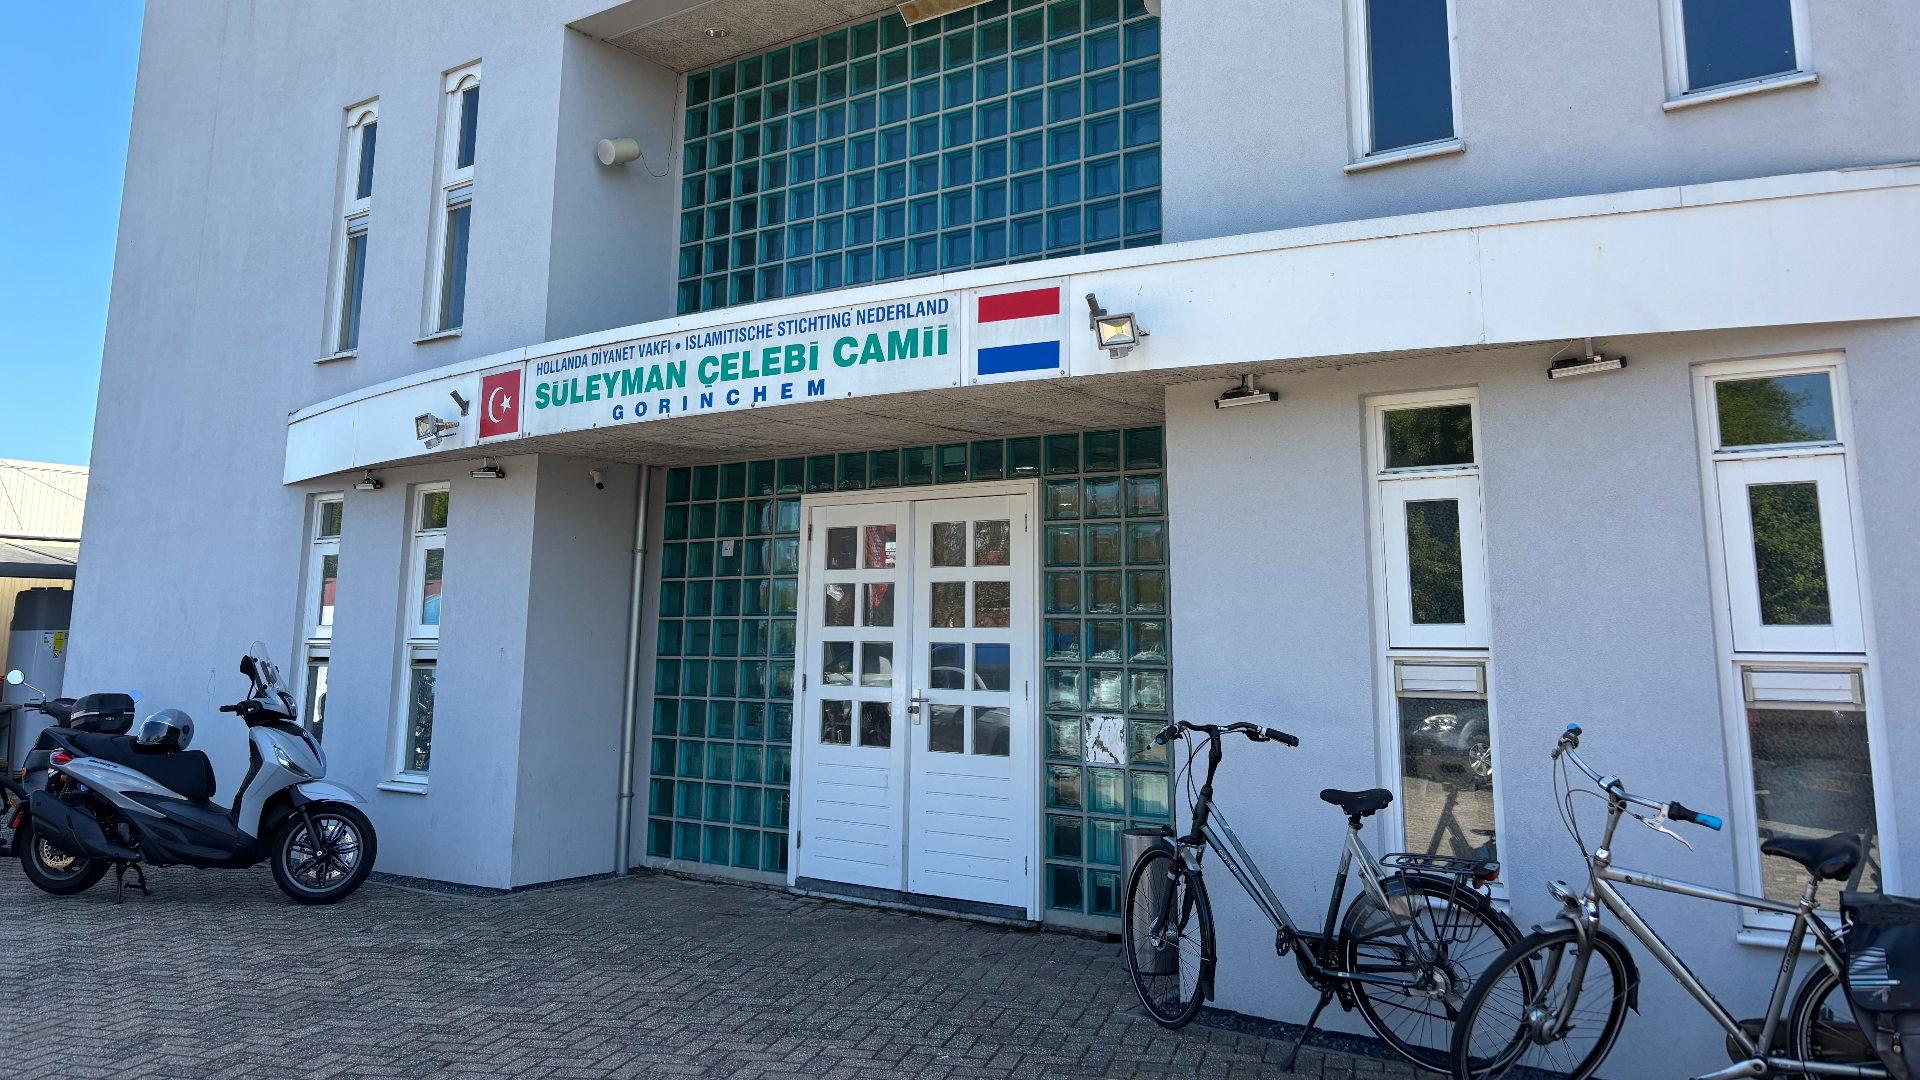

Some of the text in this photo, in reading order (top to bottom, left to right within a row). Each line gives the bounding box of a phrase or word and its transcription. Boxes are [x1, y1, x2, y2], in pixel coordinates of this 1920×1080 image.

[536, 354, 588, 376] HOLLANDA
[638, 340, 671, 358] VAKFI
[685, 323, 773, 350] ISLAMITISCHE
[778, 311, 851, 337] STICHTING
[857, 298, 949, 325] NEDERLAND
[535, 360, 687, 409] SÜLEYMAN
[698, 341, 819, 388] ÇELEBİ
[613, 379, 825, 420] GORINCHEM
[1783, 935, 1797, 973] Gazelle
